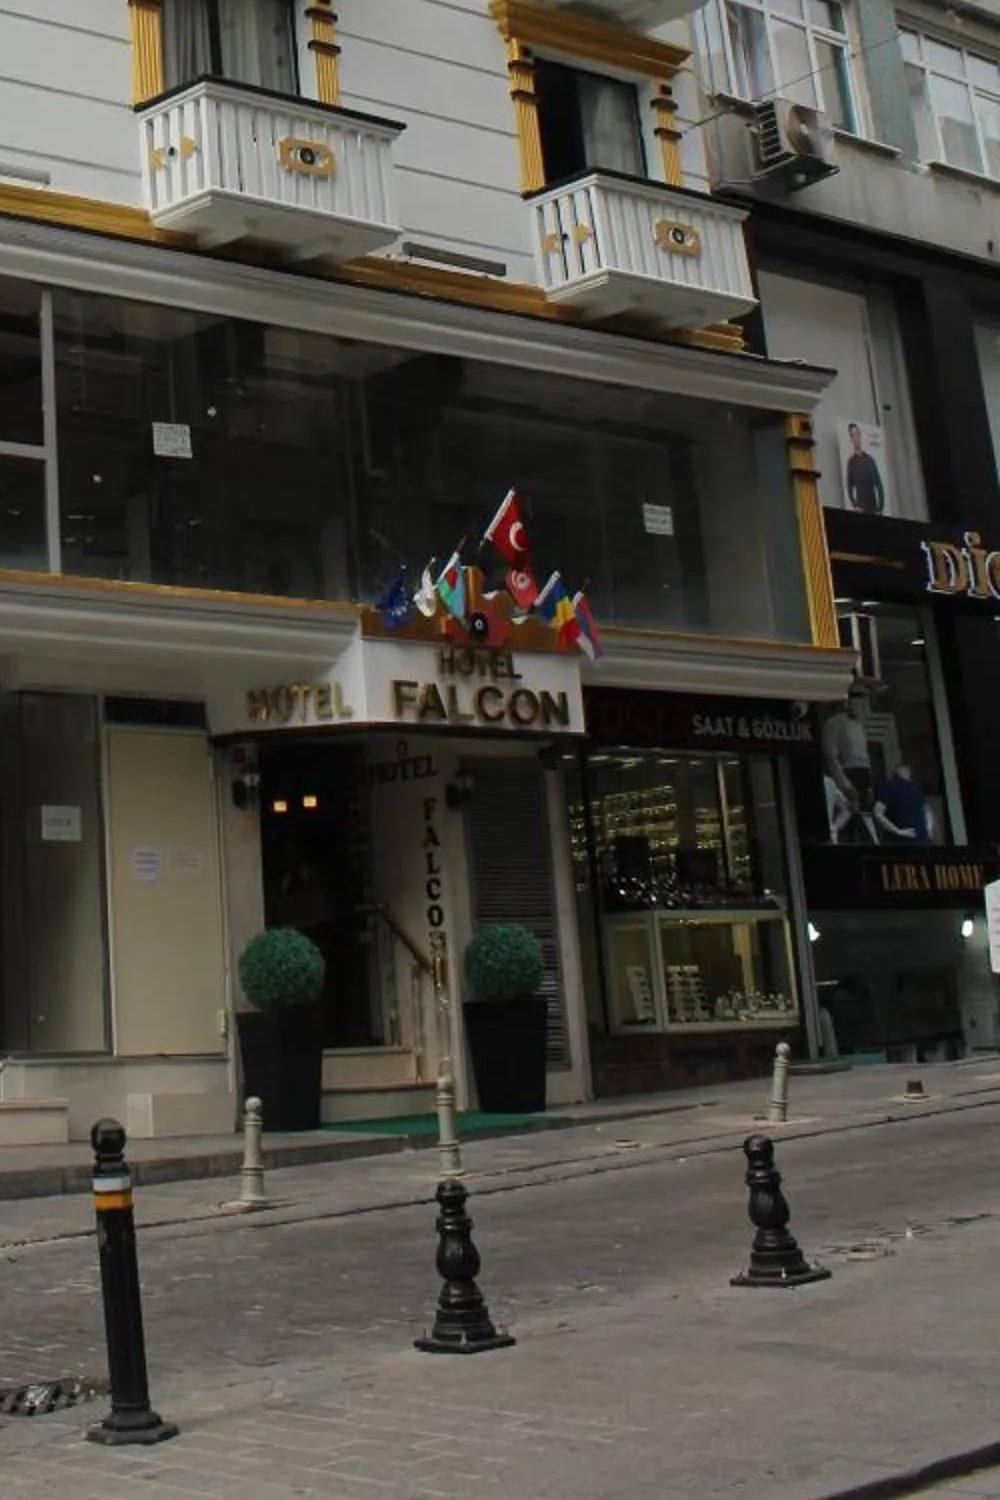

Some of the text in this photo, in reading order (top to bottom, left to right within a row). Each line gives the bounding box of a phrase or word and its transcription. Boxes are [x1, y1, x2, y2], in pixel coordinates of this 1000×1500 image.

[438, 648, 522, 679] HOTEL
[393, 679, 569, 726] FALCON
[692, 711, 734, 738] SAAT
[737, 715, 751, 738] &
[368, 754, 438, 786] HOTEL
